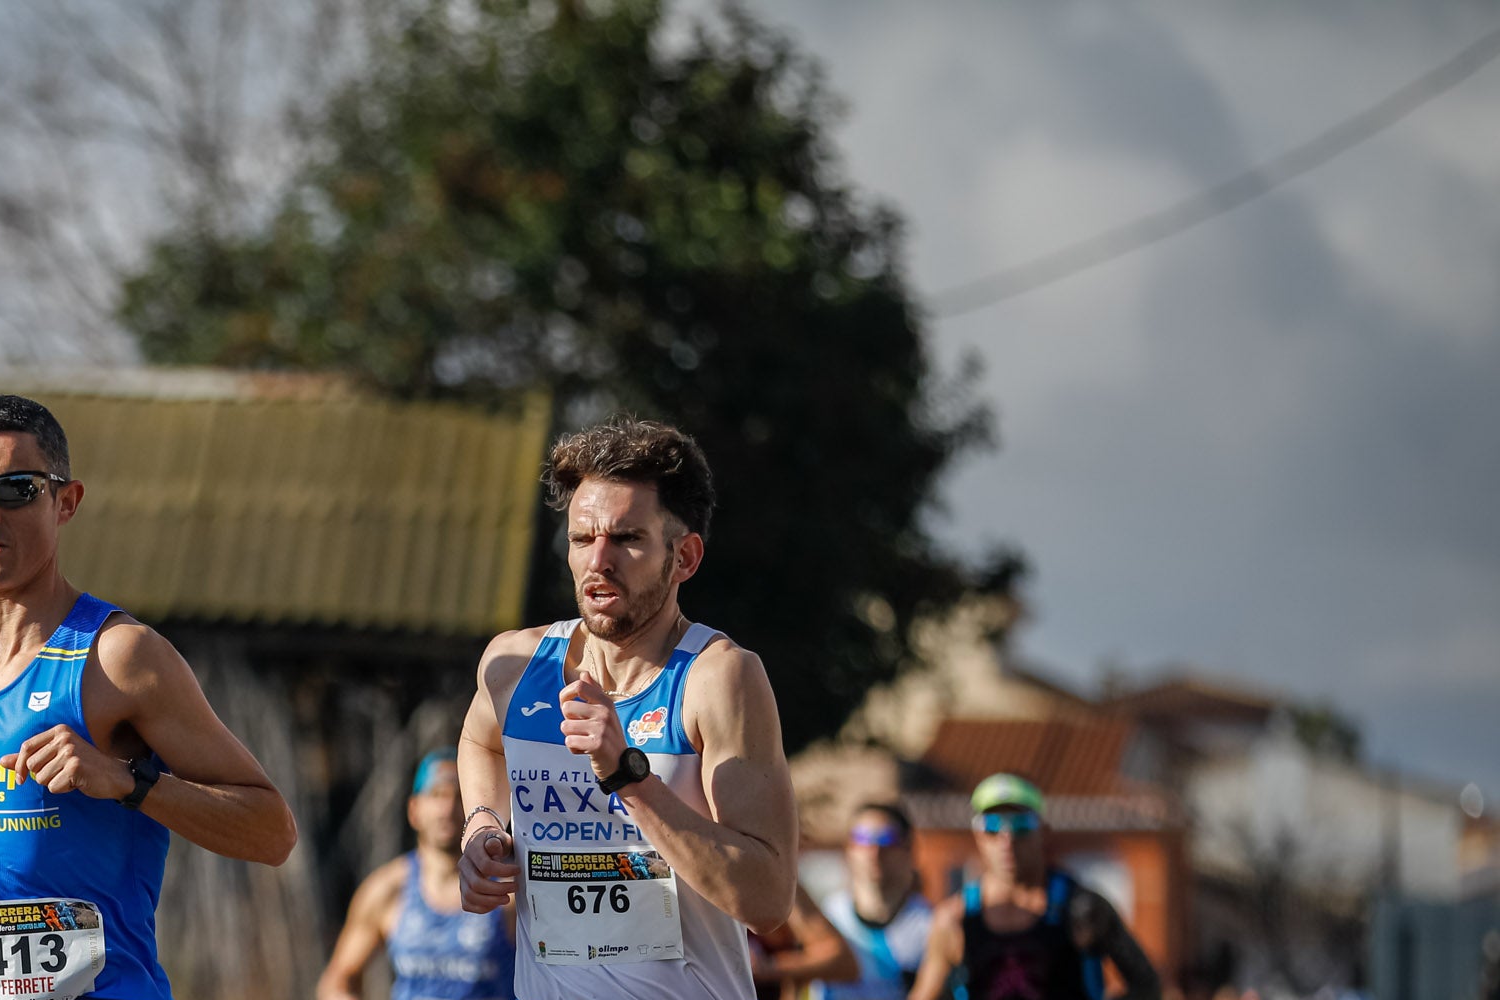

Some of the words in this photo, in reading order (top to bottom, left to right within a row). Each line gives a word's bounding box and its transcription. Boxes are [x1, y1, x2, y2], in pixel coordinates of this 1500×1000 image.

[510, 770, 550, 782] CLUB
[515, 785, 630, 816] CAXA
[531, 854, 543, 865] 26
[561, 855, 615, 864] CARRERA
[562, 863, 615, 871] POPULAR
[567, 884, 630, 914] 676
[598, 945, 629, 954] olimpo
[0, 976, 55, 995] FERRETE
